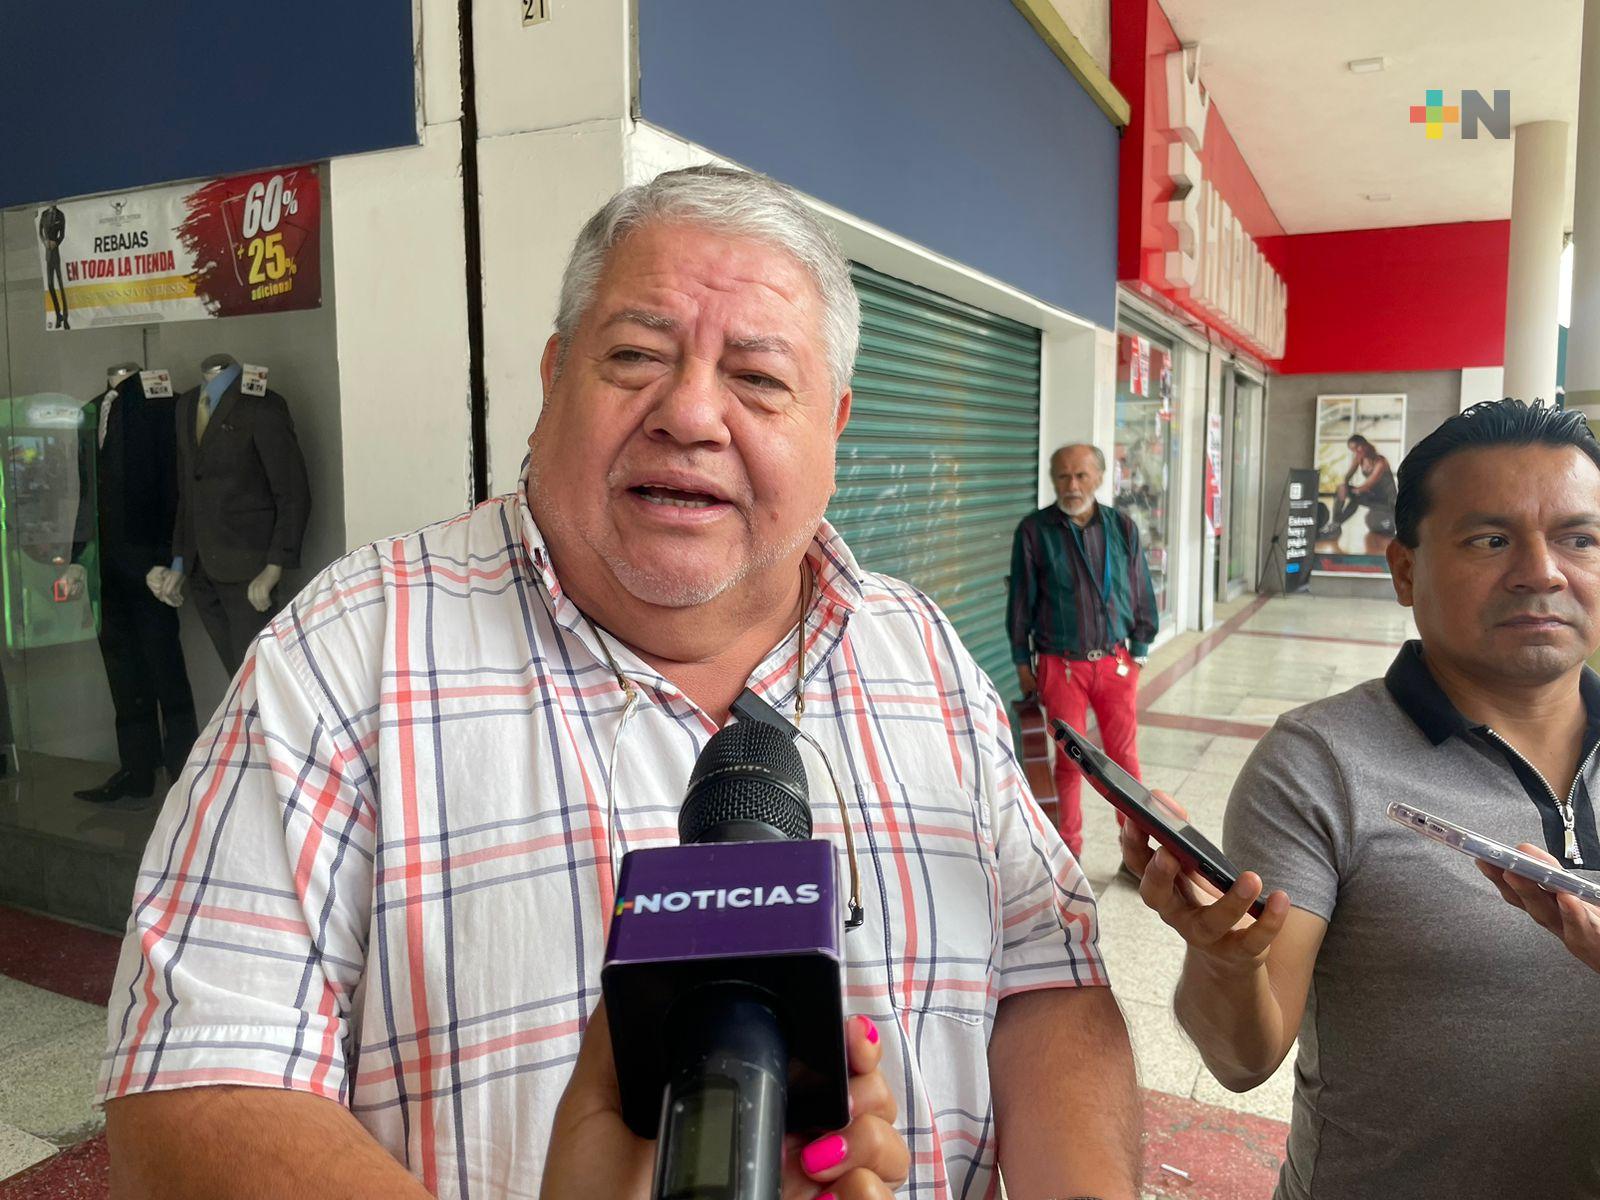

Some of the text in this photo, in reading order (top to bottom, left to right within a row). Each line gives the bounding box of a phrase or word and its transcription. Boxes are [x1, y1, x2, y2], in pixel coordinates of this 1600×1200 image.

[243, 174, 298, 239] 60%
[94, 230, 149, 253] REBAJAS
[66, 250, 175, 281] EN TODA LA TIENDA
[251, 278, 293, 301] adicional
